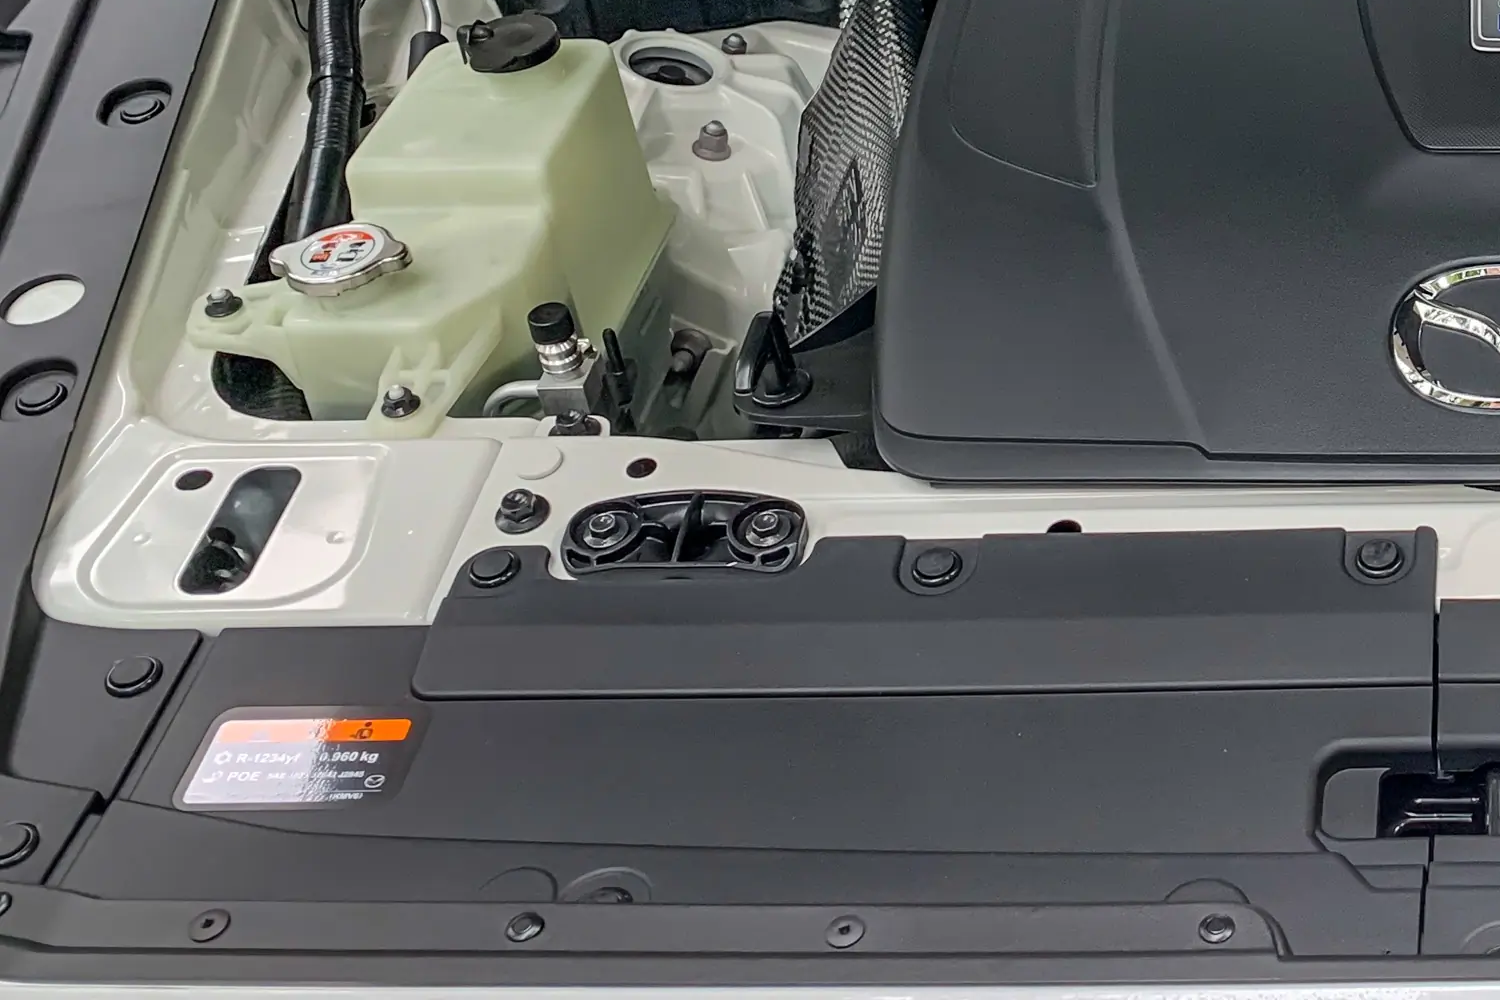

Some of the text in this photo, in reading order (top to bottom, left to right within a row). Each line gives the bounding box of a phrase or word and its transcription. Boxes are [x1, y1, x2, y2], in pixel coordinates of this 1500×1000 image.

[235, 751, 379, 765] R-1234yf 0.960 kg
[226, 771, 261, 782] POE
